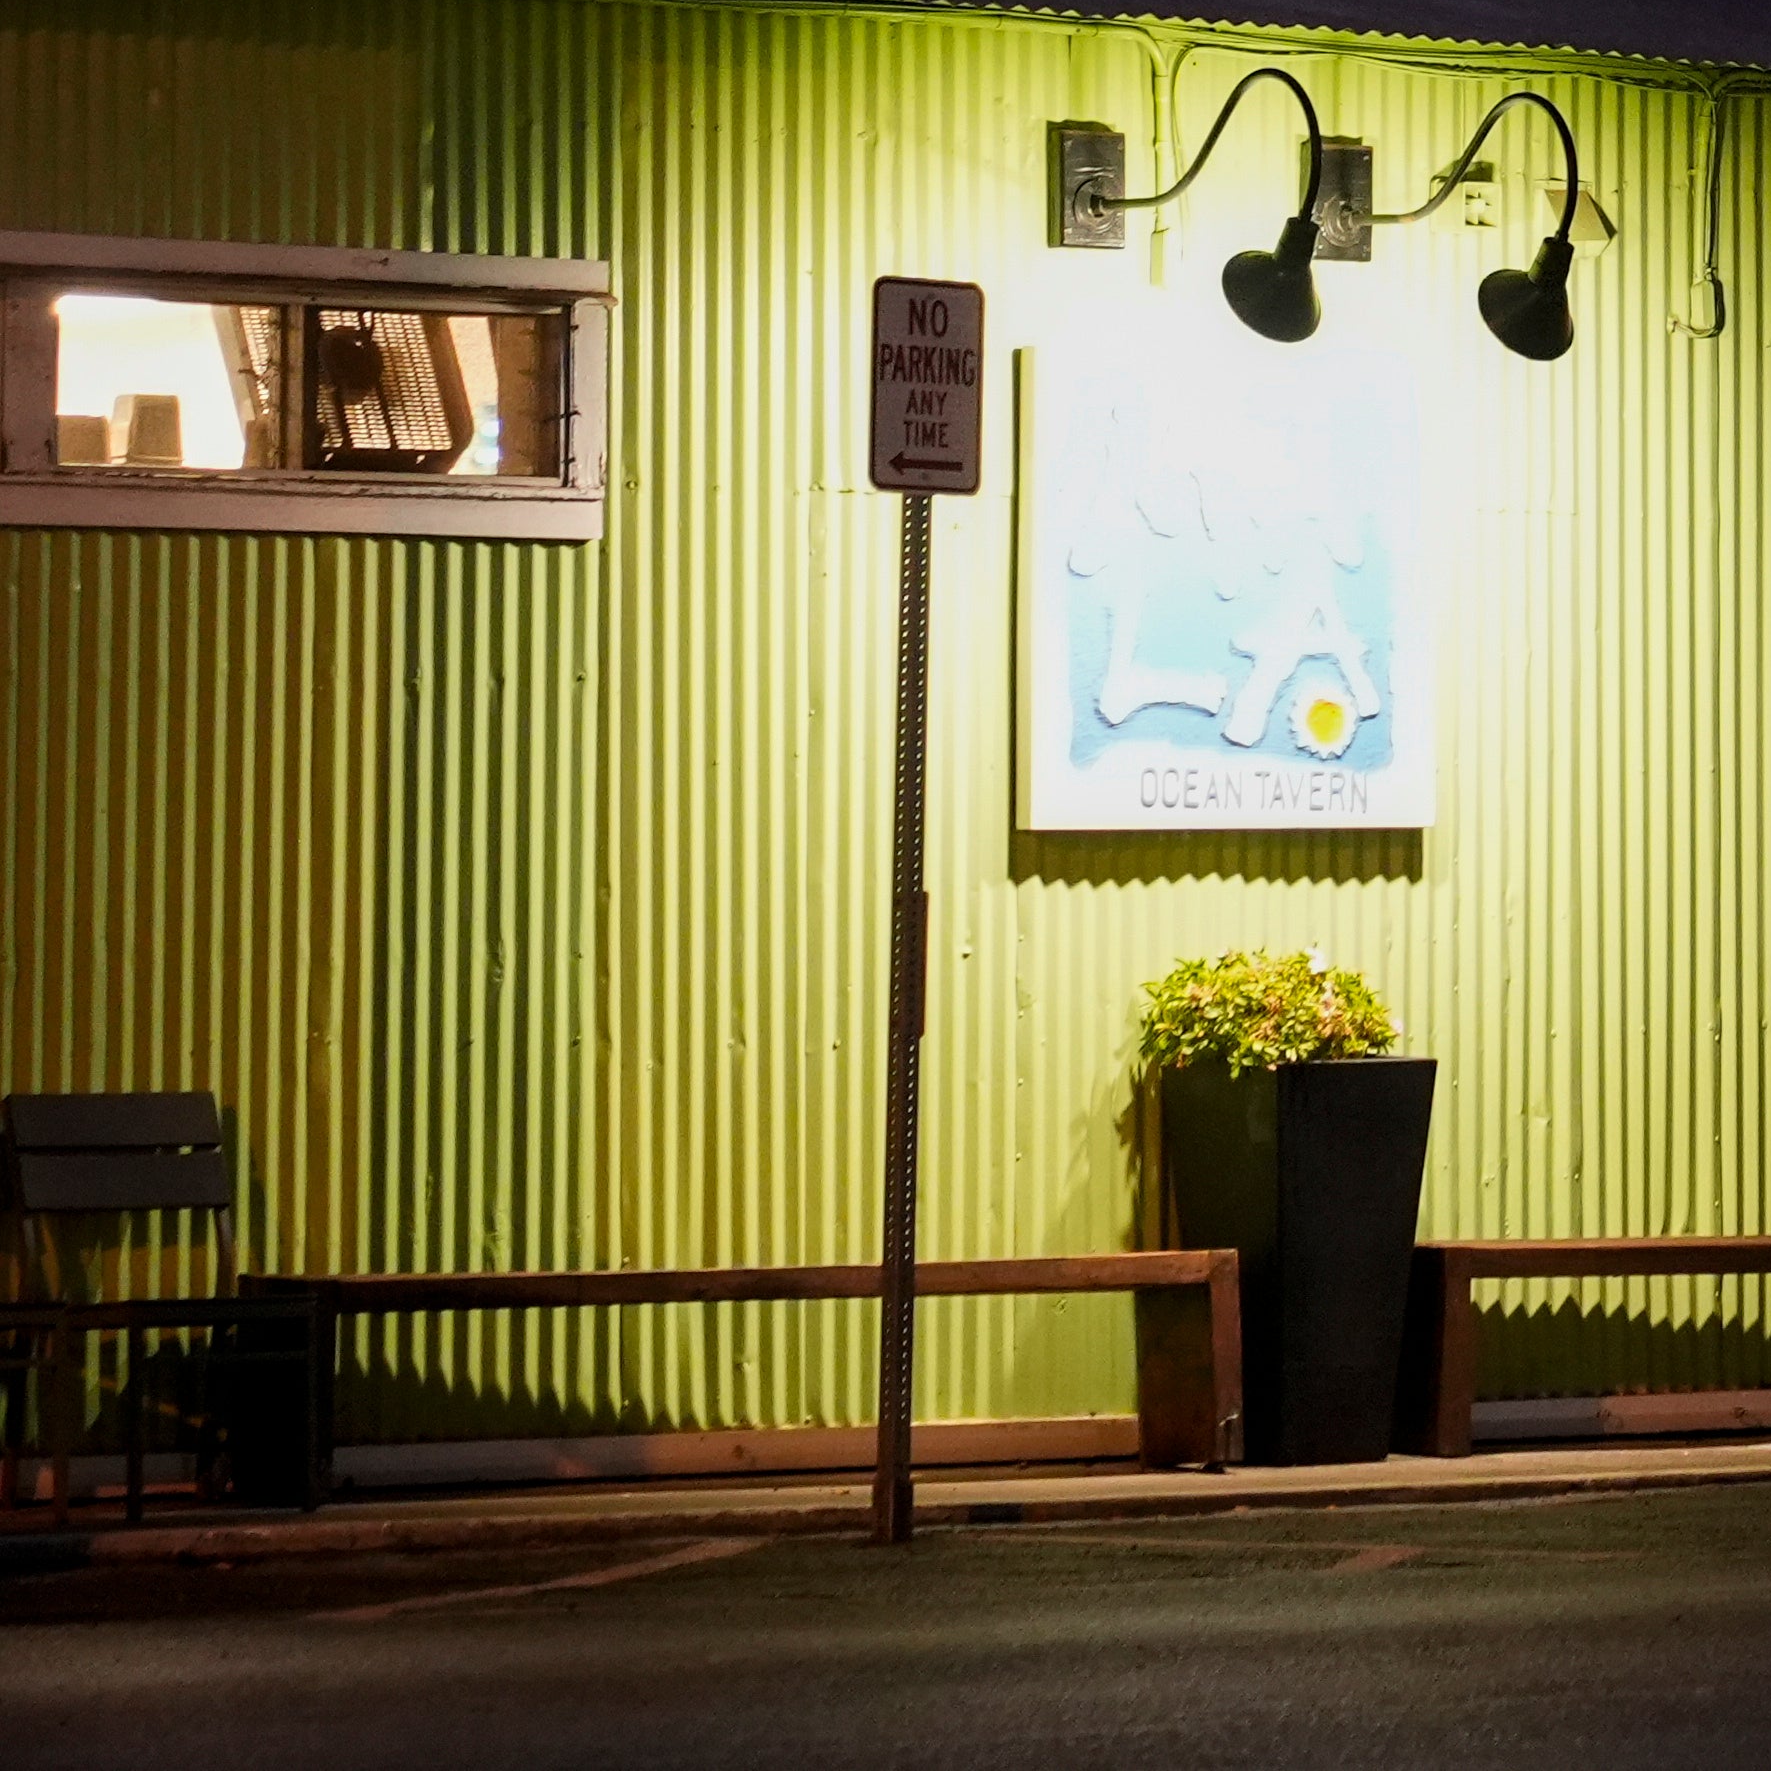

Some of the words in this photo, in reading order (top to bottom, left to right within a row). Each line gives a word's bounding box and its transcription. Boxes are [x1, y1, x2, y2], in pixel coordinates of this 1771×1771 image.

[907, 297, 949, 338] NO
[878, 343, 977, 388] PARKING
[904, 388, 948, 417] ANY
[902, 420, 950, 449] TIME
[1140, 767, 1243, 810] OCEAN
[1254, 770, 1369, 814] TAVERN
